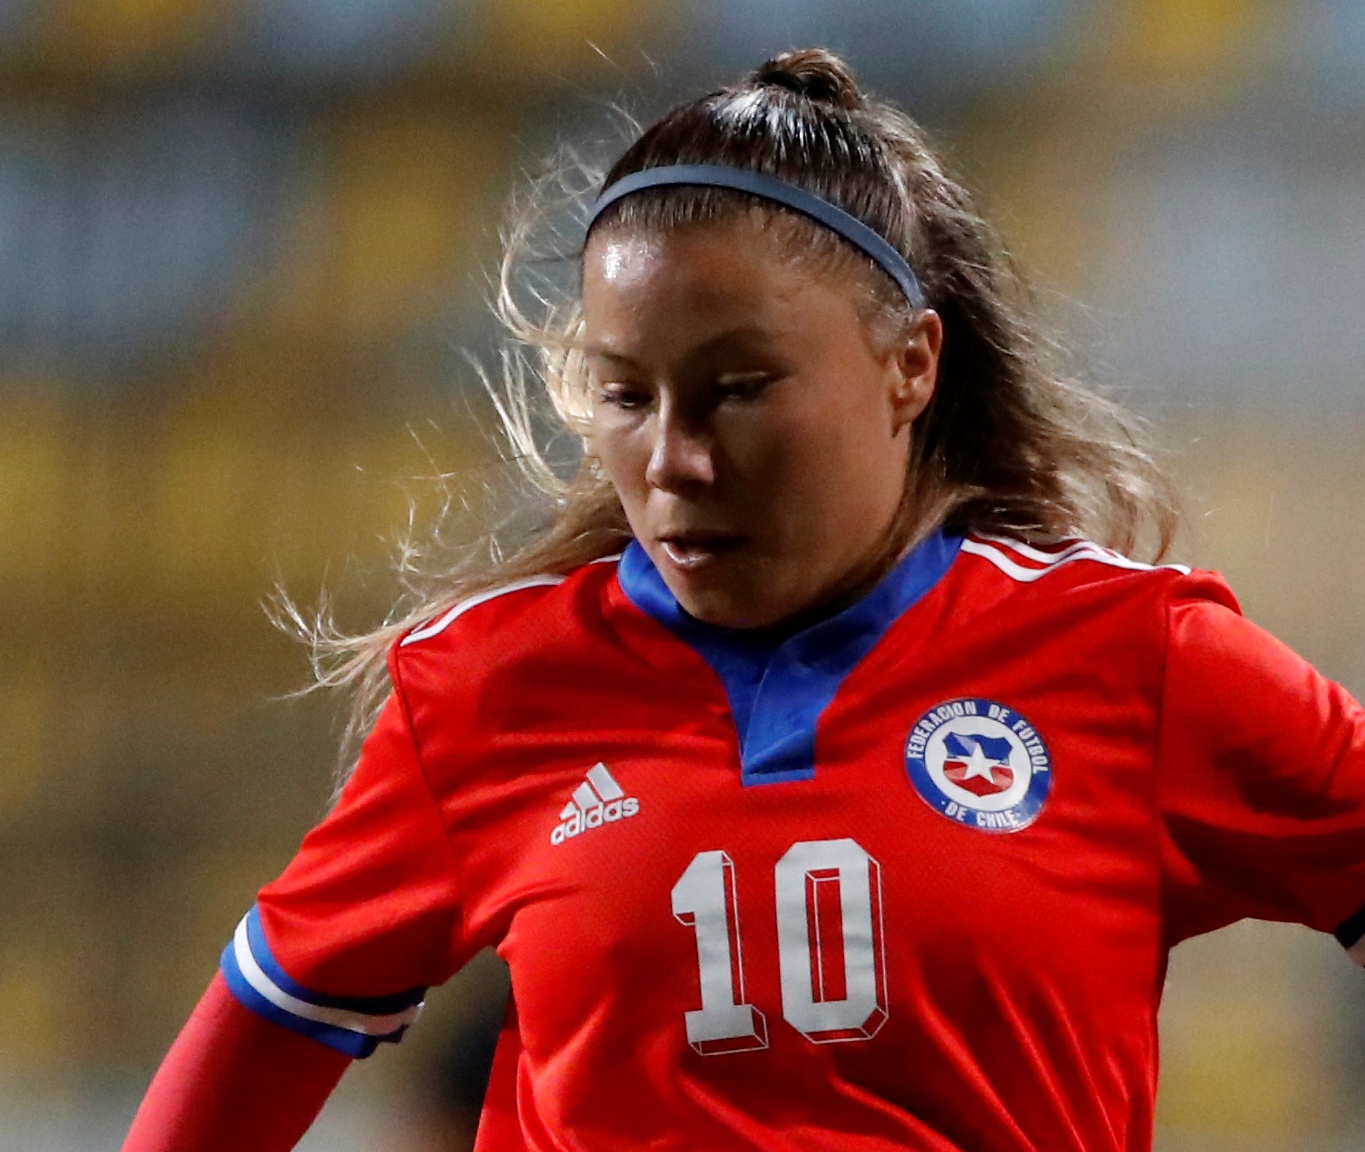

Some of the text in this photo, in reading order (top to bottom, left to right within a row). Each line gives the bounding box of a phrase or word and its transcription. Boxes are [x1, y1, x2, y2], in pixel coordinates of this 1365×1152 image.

[907, 701, 1049, 774] FEDERACION DE FUTBOL
[550, 797, 640, 846] adidas
[944, 801, 1020, 828] DE CHILE
[670, 837, 889, 1056] 10
